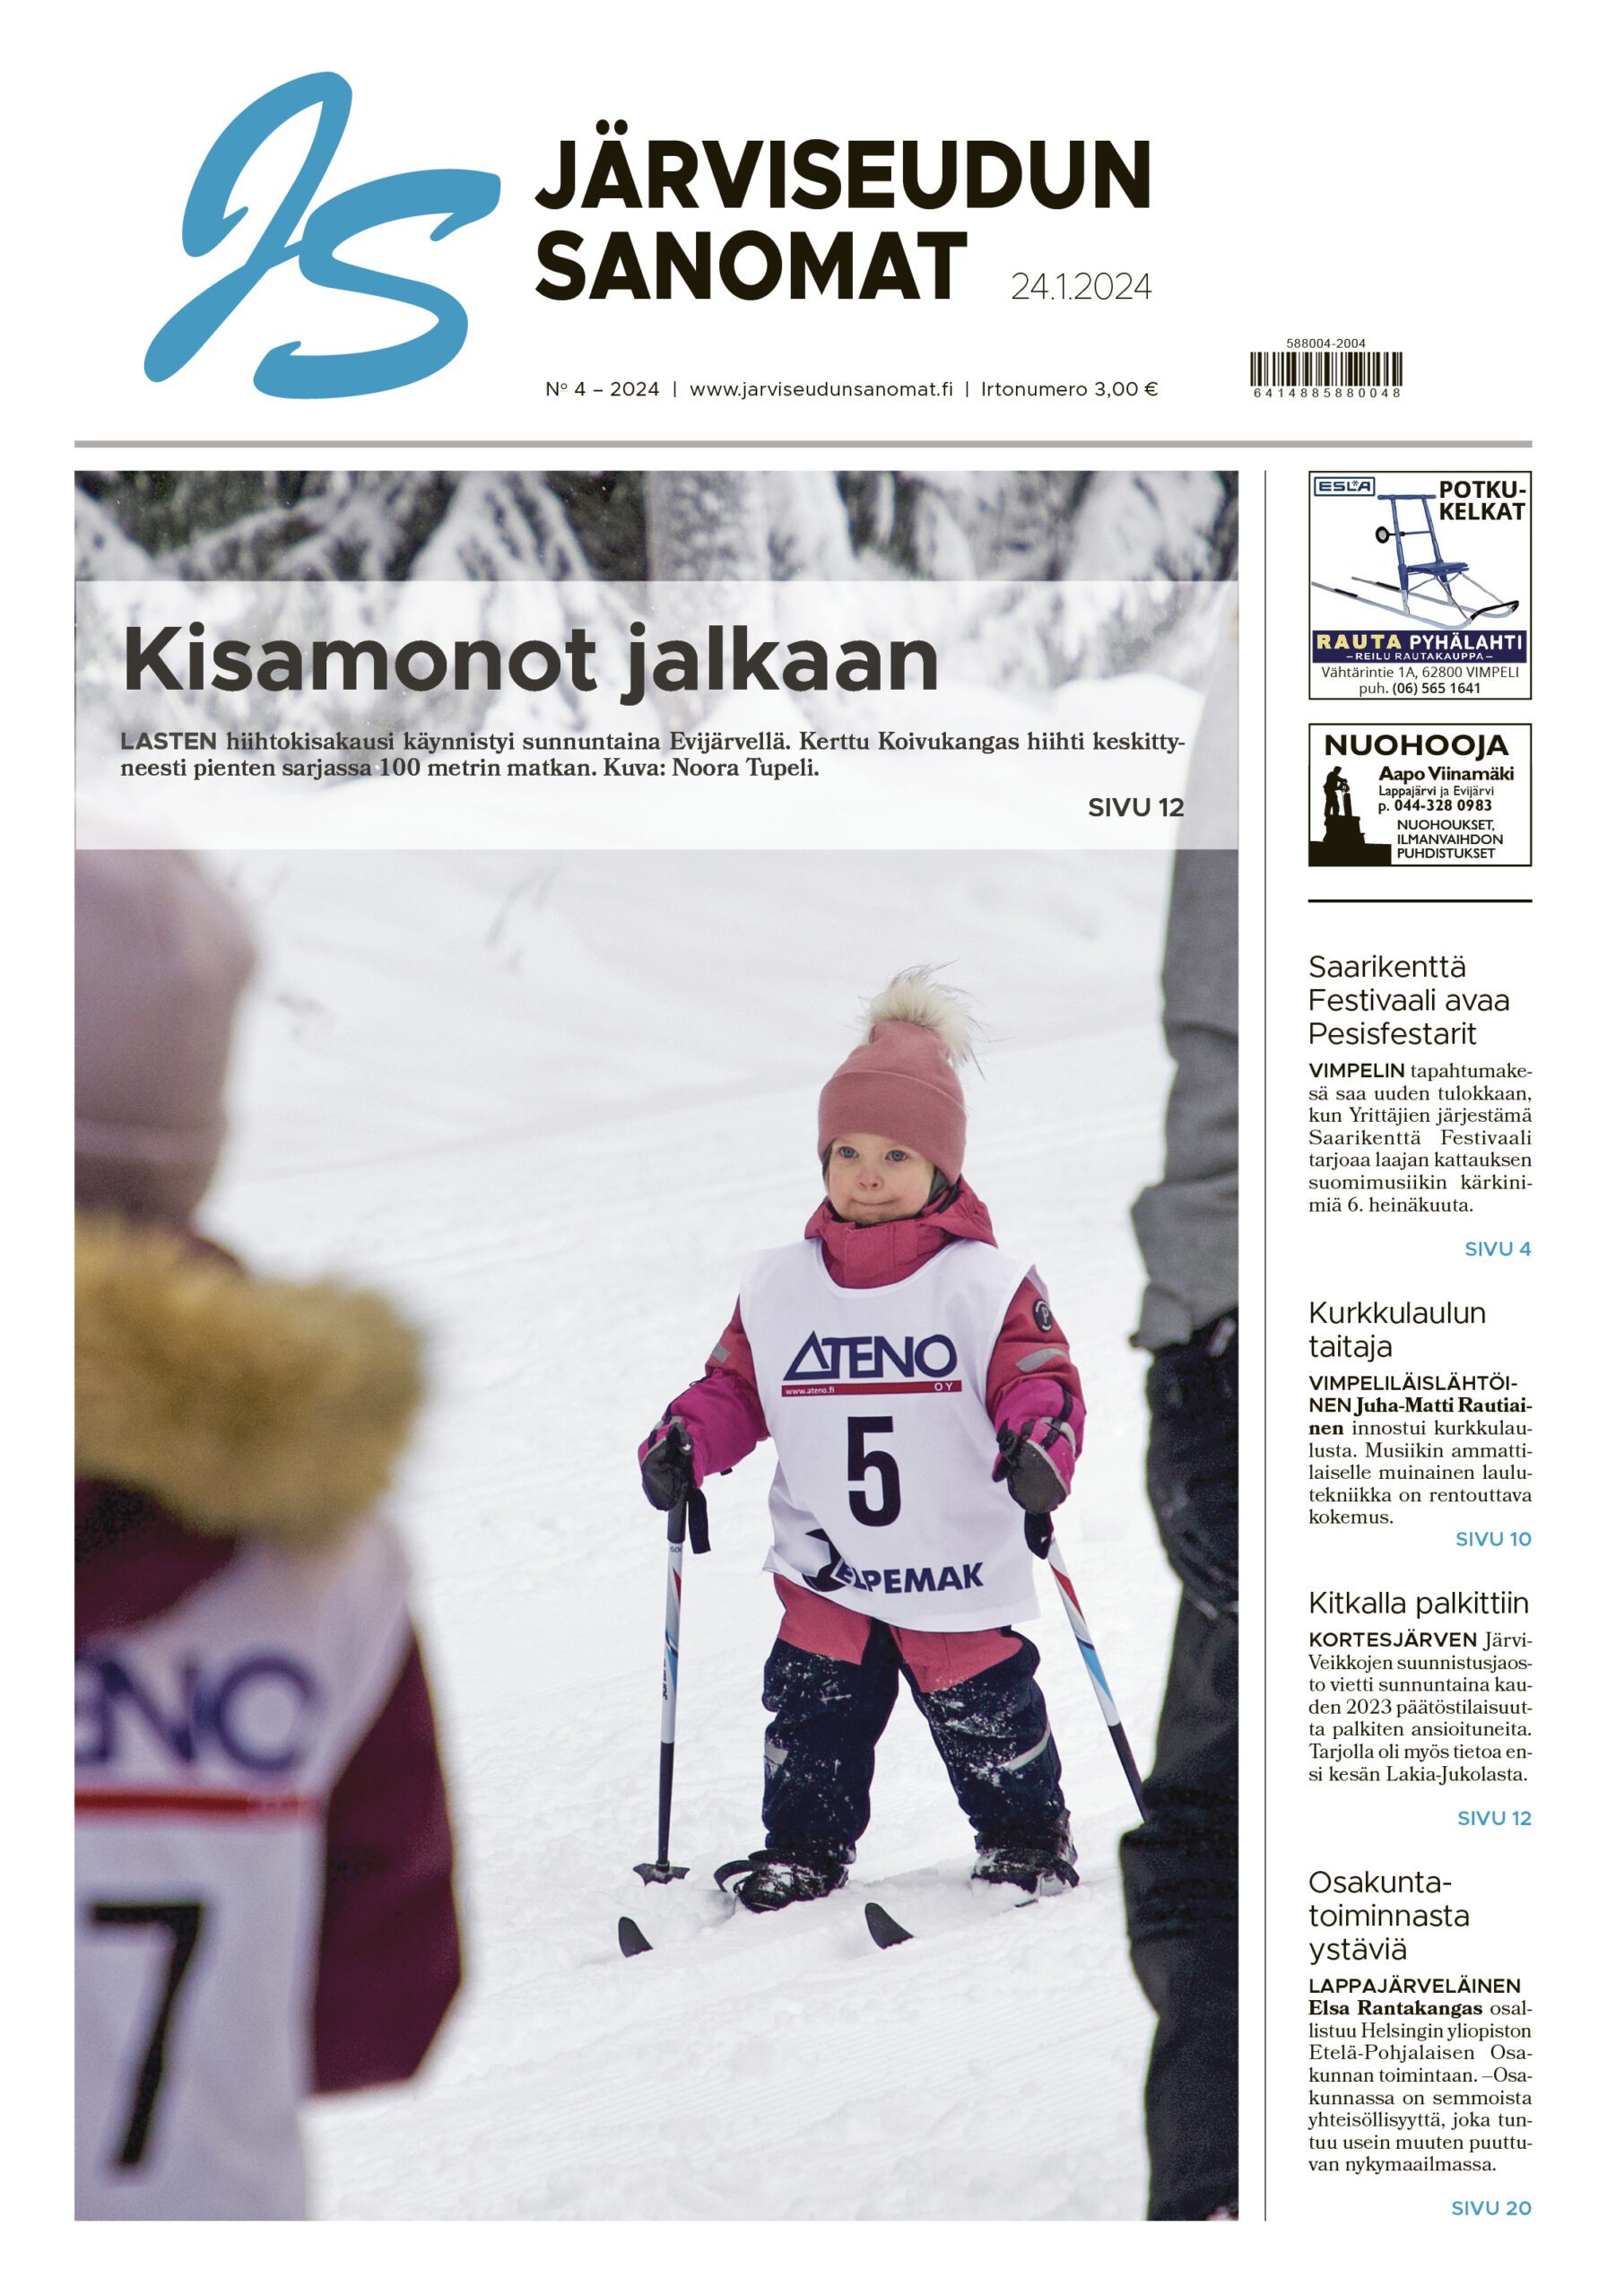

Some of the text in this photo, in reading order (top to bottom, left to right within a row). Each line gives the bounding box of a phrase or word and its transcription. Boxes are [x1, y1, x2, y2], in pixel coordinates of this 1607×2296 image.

[534, 119, 1150, 209] JÄRVISEUDUN
[535, 230, 968, 300] SANOMAT
[1012, 273, 1151, 300] 24.1.2024
[1287, 339, 1365, 348] 588004-2004
[575, 382, 586, 396] 4
[611, 382, 659, 396] 2024
[691, 382, 952, 399] www.jarviseudunsanomat.fi
[983, 382, 1087, 396] Irtonumero
[1095, 382, 1138, 398] 3,00
[1144, 382, 1158, 396] €
[1440, 481, 1526, 498] POTKU-
[1440, 503, 1525, 520] KELKAT
[1317, 632, 1521, 649] RAUTA PYHÄLAHTI
[127, 622, 936, 705] Kisamonot jalkaan
[1322, 666, 1518, 679] Vähtärintie 1A, 62800 VIMPELI
[1359, 683, 1480, 697] puh. (06) 565 1641
[122, 732, 1185, 753] LASTEN hiihtokisakausi käynnistyi sunnuntaina Evijärvellä. Kerttu Koivukangas hiihti keskitty-
[1325, 735, 1509, 761] NUOHOOJA
[121, 758, 818, 779] neesti pienten sarjassa 100 metrin matkan. Kuva: Noora Tupeli.
[1379, 766, 1514, 785] Aapo Viinamäki
[1379, 786, 1493, 798] Lappajärvi ja Evijärvi
[1090, 798, 1184, 816] SIVU 12
[1378, 799, 1491, 814] p. 044-328 0983
[1398, 820, 1494, 831] NUOHOUKSET,
[1398, 834, 1503, 844] ILMANVAIHDON
[1398, 848, 1496, 858] PUHDISTUKSET
[1310, 954, 1465, 978] Saarikenttä
[1310, 988, 1509, 1011] Festivaali avaa
[1310, 1022, 1476, 1045] Pesisfestarit
[1309, 1063, 1532, 1081] VIMPELIN tapahtumake-
[1309, 1085, 1531, 1102] sä saa uuden tulokkaan,
[1309, 1107, 1532, 1126] kun Yrittäjien järjestämä
[1309, 1129, 1532, 1144] Saarikenttä Festivaali
[1309, 1152, 1532, 1170] tarjoaa laajan kattauksen
[1309, 1174, 1532, 1189] suomimusiikin kärkini-
[1309, 1196, 1472, 1212] miä 6. heinäkuuta.
[1466, 1242, 1531, 1256] SIVU 4
[1311, 1301, 1485, 1324] Kurkkulaulun
[783, 1331, 957, 1380] ATENO
[1309, 1335, 1392, 1362] taitaja
[1309, 1372, 1517, 1390] VIMPELILÄISLÄHTÖI-
[786, 1387, 835, 1396] www.ateno.fi
[1310, 1397, 1533, 1417] NEN Juha-Matti Rautiai-
[1309, 1420, 1532, 1435] nen innostui kurkkulau-
[847, 1416, 901, 1527] 5
[1309, 1465, 1532, 1479] laiselle muinainen laulu-
[1309, 1487, 1532, 1501] tekniikka on rentouttava
[1309, 1509, 1393, 1524] kokemus.
[1457, 1532, 1531, 1546] SIVU 10
[1311, 1591, 1528, 1619] Kitkalla palkittiin
[1310, 1629, 1532, 1651] KORTESJÄRVEN Järvi-
[1308, 1655, 1532, 1673] Veikkojen suunnistusjaos-
[1309, 1676, 1533, 1692] to vietti sunnuntaina kau-
[1308, 1699, 1532, 1718] den 2023 päätöstilaisuut-
[1309, 1721, 1531, 1739] ta palkiten ansioituneita.
[1459, 1812, 1531, 1825] SIVU 12
[1309, 1871, 1451, 1893] Osakunta-
[1309, 1904, 1469, 1926] toiminnasta
[1309, 1937, 1406, 1965] ystäviä
[1310, 1975, 1520, 1993] LAPPAJÄRVELÄINEN
[1308, 2000, 1532, 2019] Elsa Rantakangas osal-
[90, 1901, 204, 2167] 7
[1309, 2022, 1531, 2041] listuu Helsingin yliopiston
[1309, 2044, 1532, 2063] Etelä-Pohjalaisen Osa-
[1309, 2067, 1374, 2082] kunnan
[1379, 2067, 1477, 2082] toimintaan.
[1308, 2156, 1496, 2174] van nykymaailmassa.
[1453, 2201, 1531, 2215] SIVU 20
